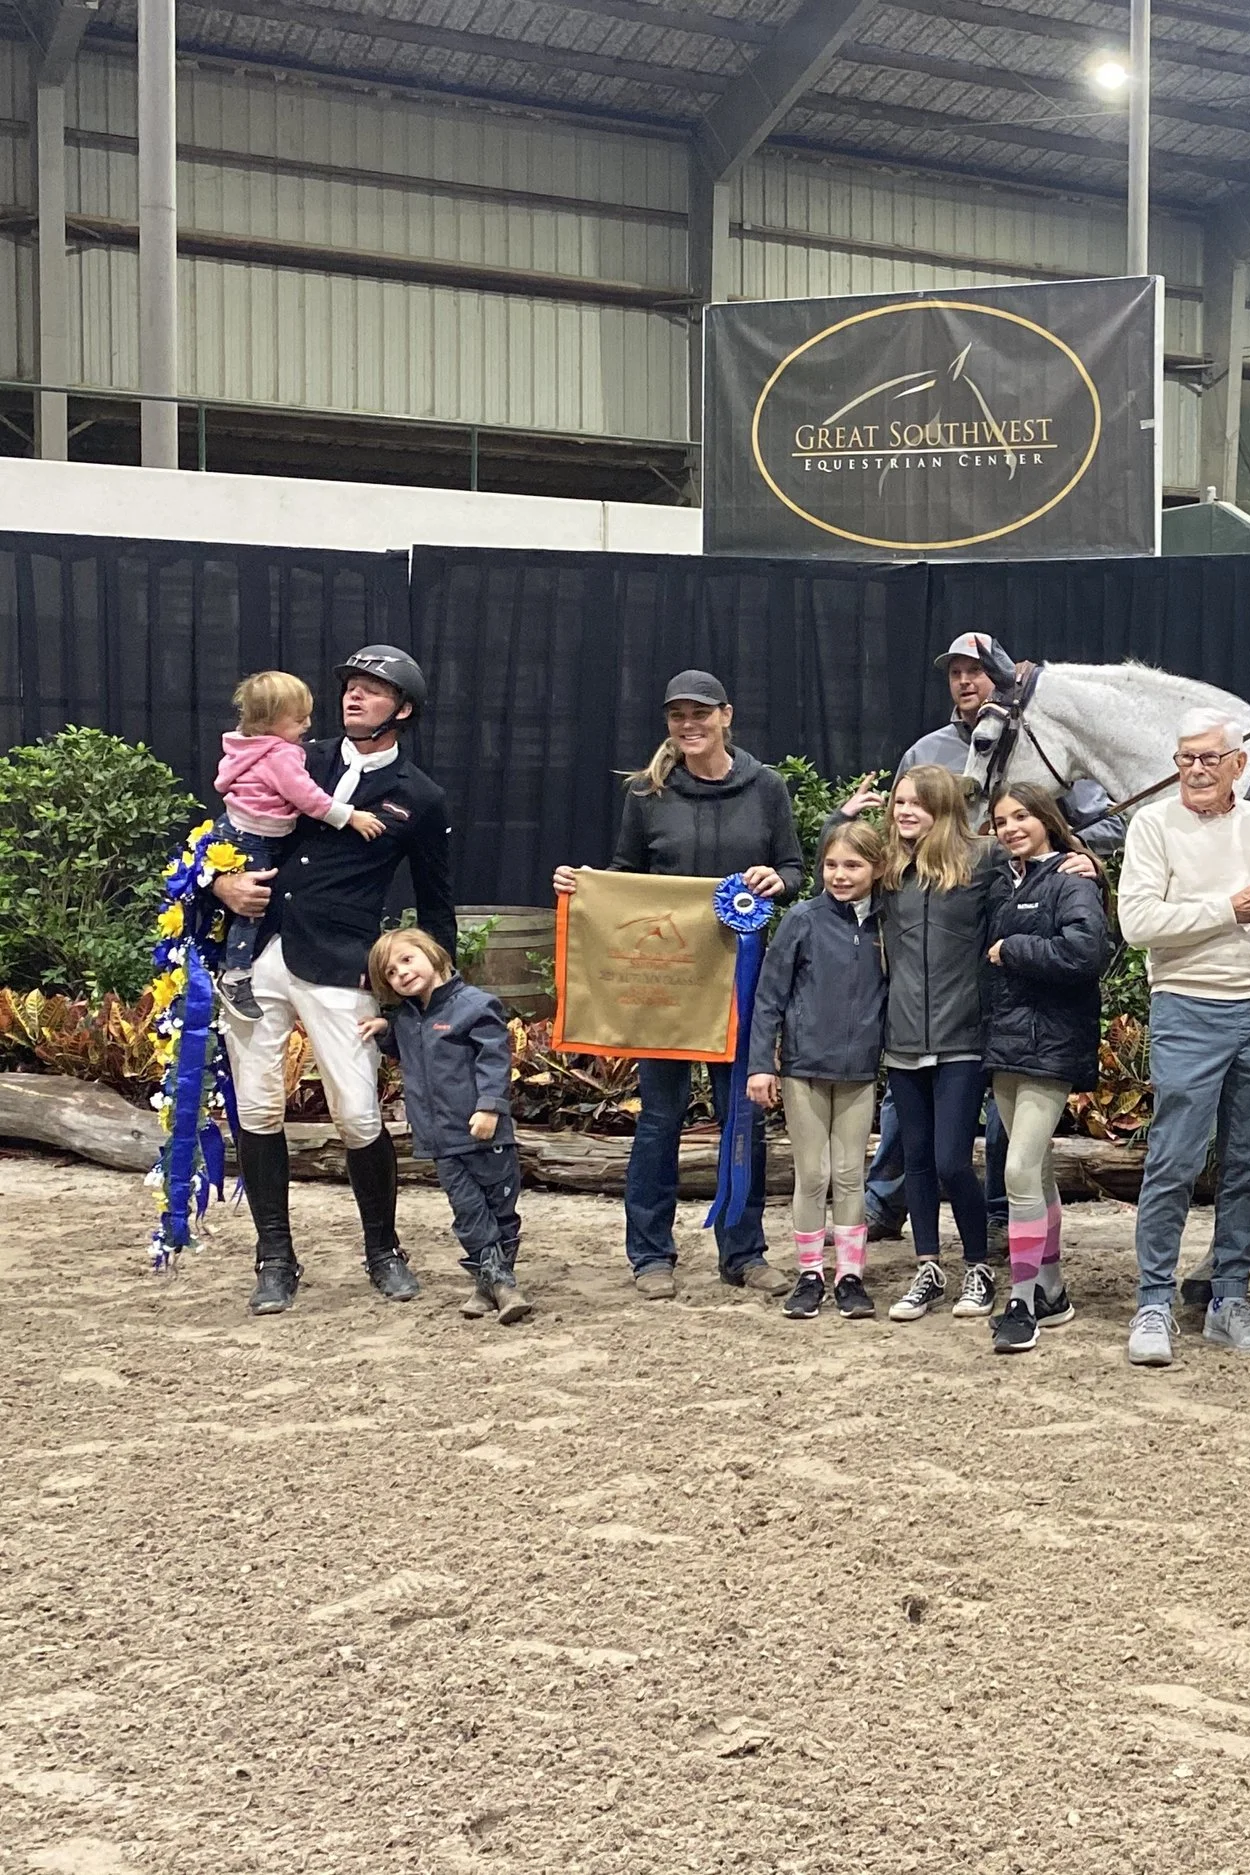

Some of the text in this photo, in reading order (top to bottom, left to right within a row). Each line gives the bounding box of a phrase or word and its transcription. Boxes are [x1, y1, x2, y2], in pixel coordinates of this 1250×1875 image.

[795, 418, 1053, 450] GREAT SOUTHWEST
[804, 453, 1043, 473] EQUESTRIAN CENTER
